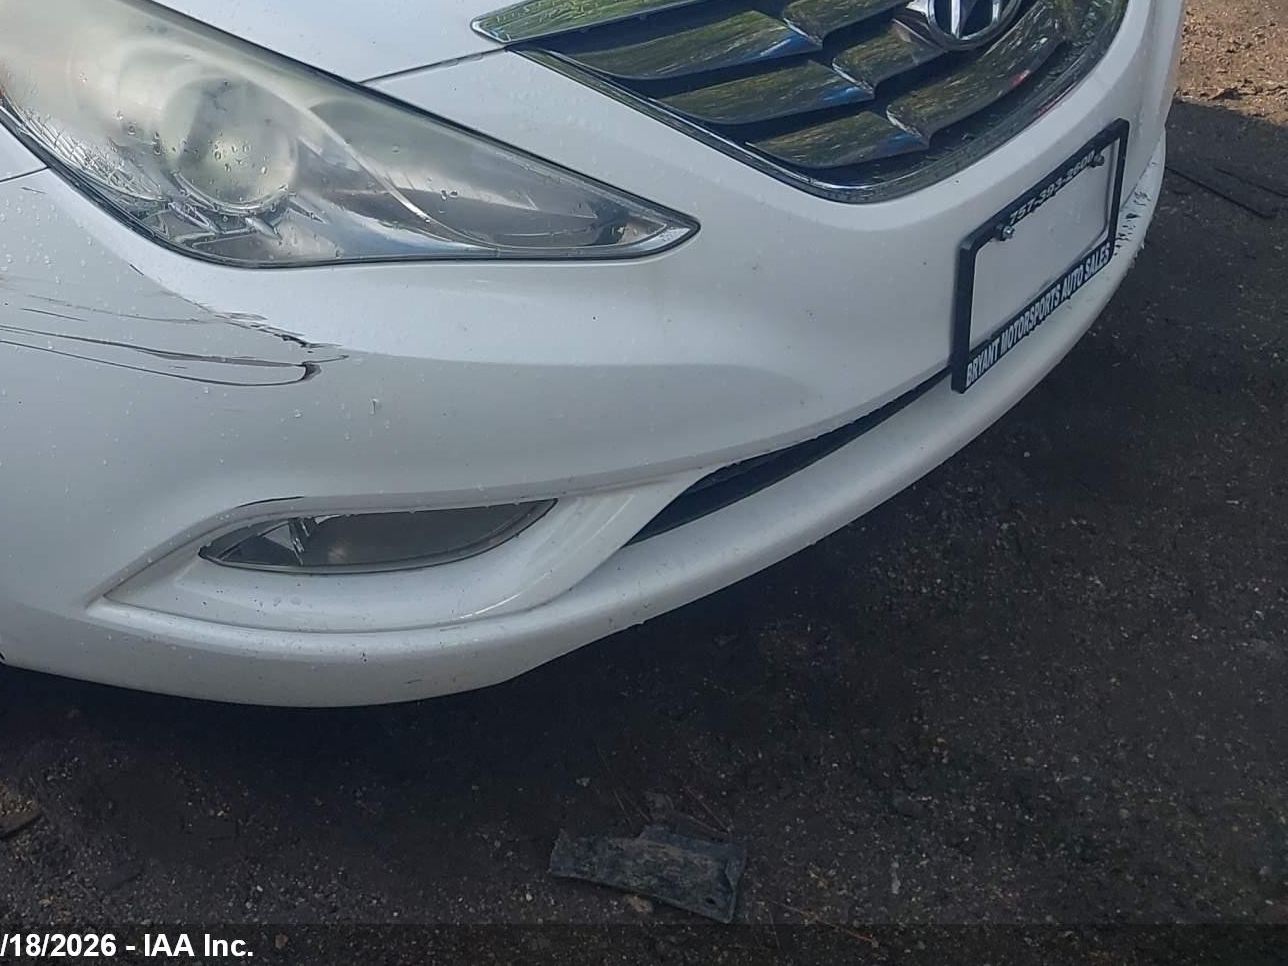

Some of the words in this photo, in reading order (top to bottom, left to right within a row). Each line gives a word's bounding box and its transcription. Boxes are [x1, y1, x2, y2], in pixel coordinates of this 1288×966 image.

[966, 336, 1001, 387] BRYANT
[1000, 284, 1062, 355] MOTORSPORTS
[1061, 265, 1084, 299] AUTO
[1084, 241, 1111, 281] SALES
